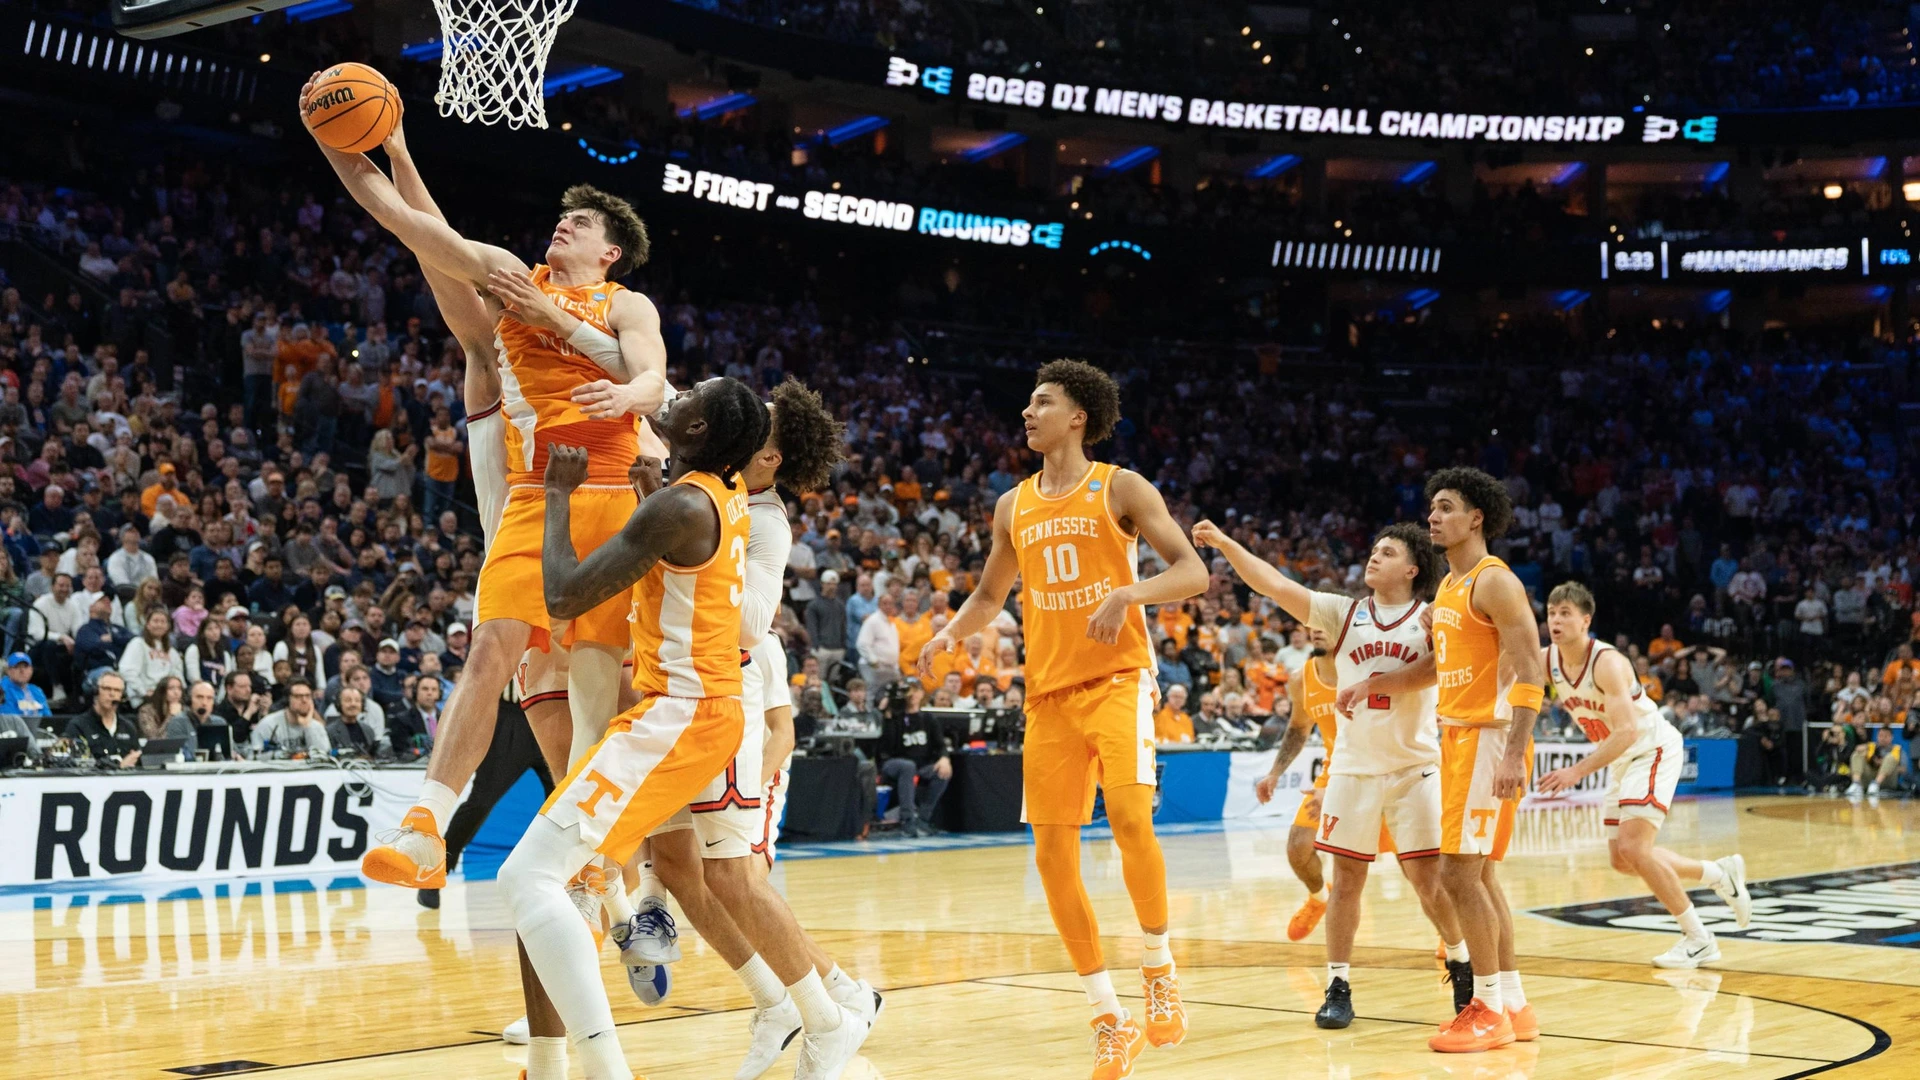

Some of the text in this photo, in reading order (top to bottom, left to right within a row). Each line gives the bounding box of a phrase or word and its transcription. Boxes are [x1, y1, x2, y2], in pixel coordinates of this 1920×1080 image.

[307, 86, 355, 116] Wilson
[967, 73, 1625, 142] 2026 DI MEN'S BASKETBALL CHAMPIONSHIP
[693, 170, 774, 211] FIRST
[803, 190, 915, 232] SECOND
[918, 206, 1032, 247] ROUNDS
[1681, 247, 1849, 272] #MARCHMADNESS
[1020, 517, 1099, 548] TENNESSEE
[1043, 543, 1080, 585] 10
[1030, 577, 1113, 611] VOLUNTEERS
[1349, 640, 1419, 666] VIRGINIA
[35, 783, 374, 880] ROUNDS
